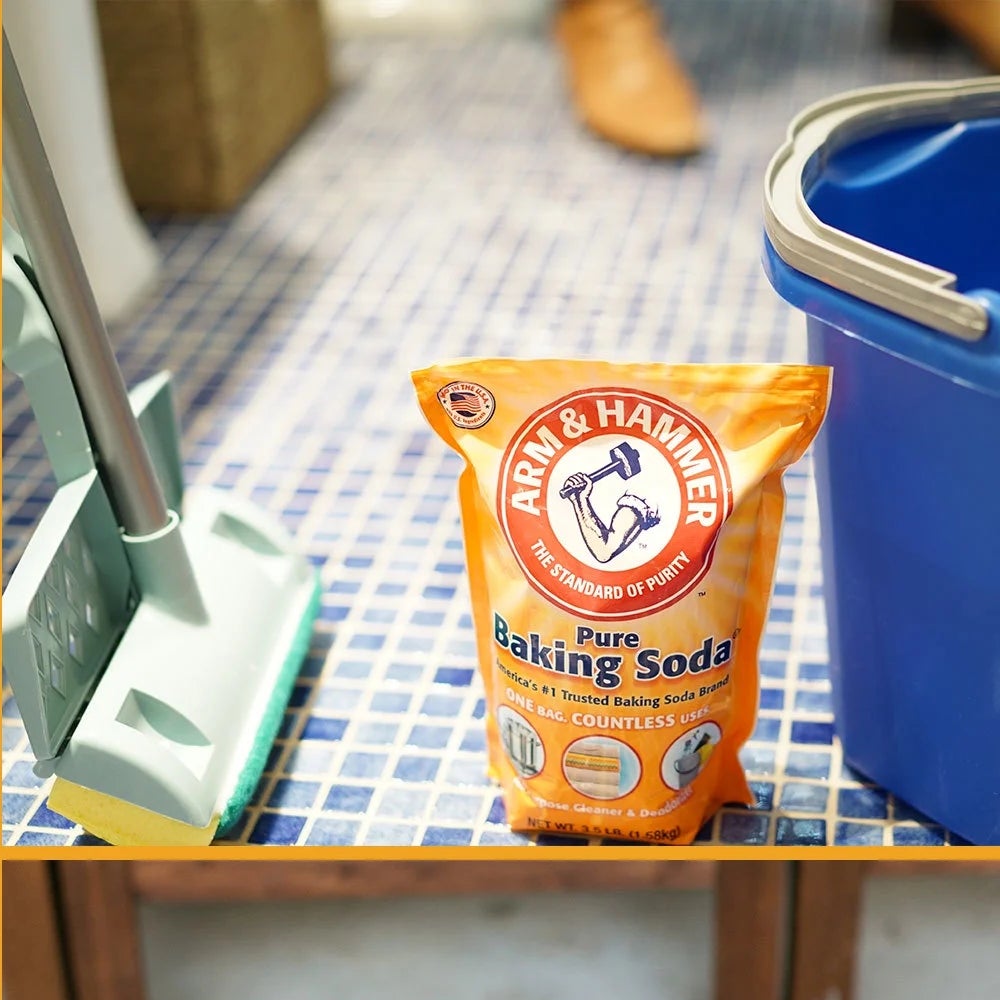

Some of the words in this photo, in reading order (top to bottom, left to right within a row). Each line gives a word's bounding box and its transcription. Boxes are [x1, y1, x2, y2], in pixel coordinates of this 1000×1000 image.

[511, 424, 565, 517] ARM
[559, 407, 594, 439] &
[596, 399, 718, 528] HAMMER
[530, 538, 555, 569] THE
[550, 563, 624, 600] STANDARD
[627, 582, 645, 598] OF
[645, 551, 692, 592] PURITY
[494, 613, 622, 688] Baking
[636, 637, 732, 680] Soda
[576, 626, 640, 648] Pure
[505, 687, 534, 712] ONE
[536, 705, 568, 723] BAG.
[572, 712, 676, 731] COUNTLESS
[541, 685, 556, 697] #1
[561, 689, 609, 706] Trusted
[614, 696, 660, 709] Baking
[664, 691, 695, 705] Soda
[699, 674, 729, 697] Brand
[527, 816, 552, 829] NET
[573, 802, 622, 817] Cleaner
[627, 807, 635, 817] &
